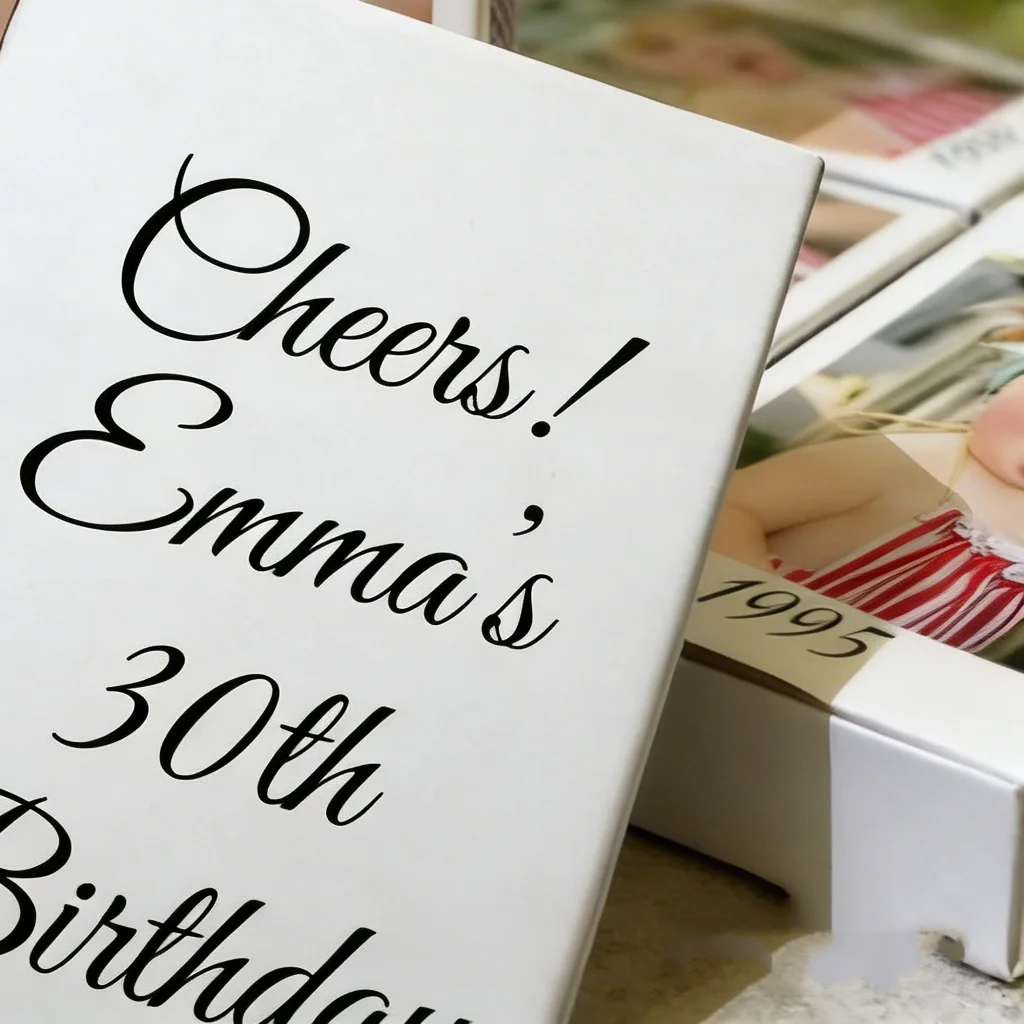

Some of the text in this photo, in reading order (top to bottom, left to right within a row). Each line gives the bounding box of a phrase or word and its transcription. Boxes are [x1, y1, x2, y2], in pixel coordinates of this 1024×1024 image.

[121, 153, 650, 437] Cheers!
[20, 373, 559, 649] Emma's
[697, 580, 895, 658] 1995
[52, 645, 396, 826] 30th
